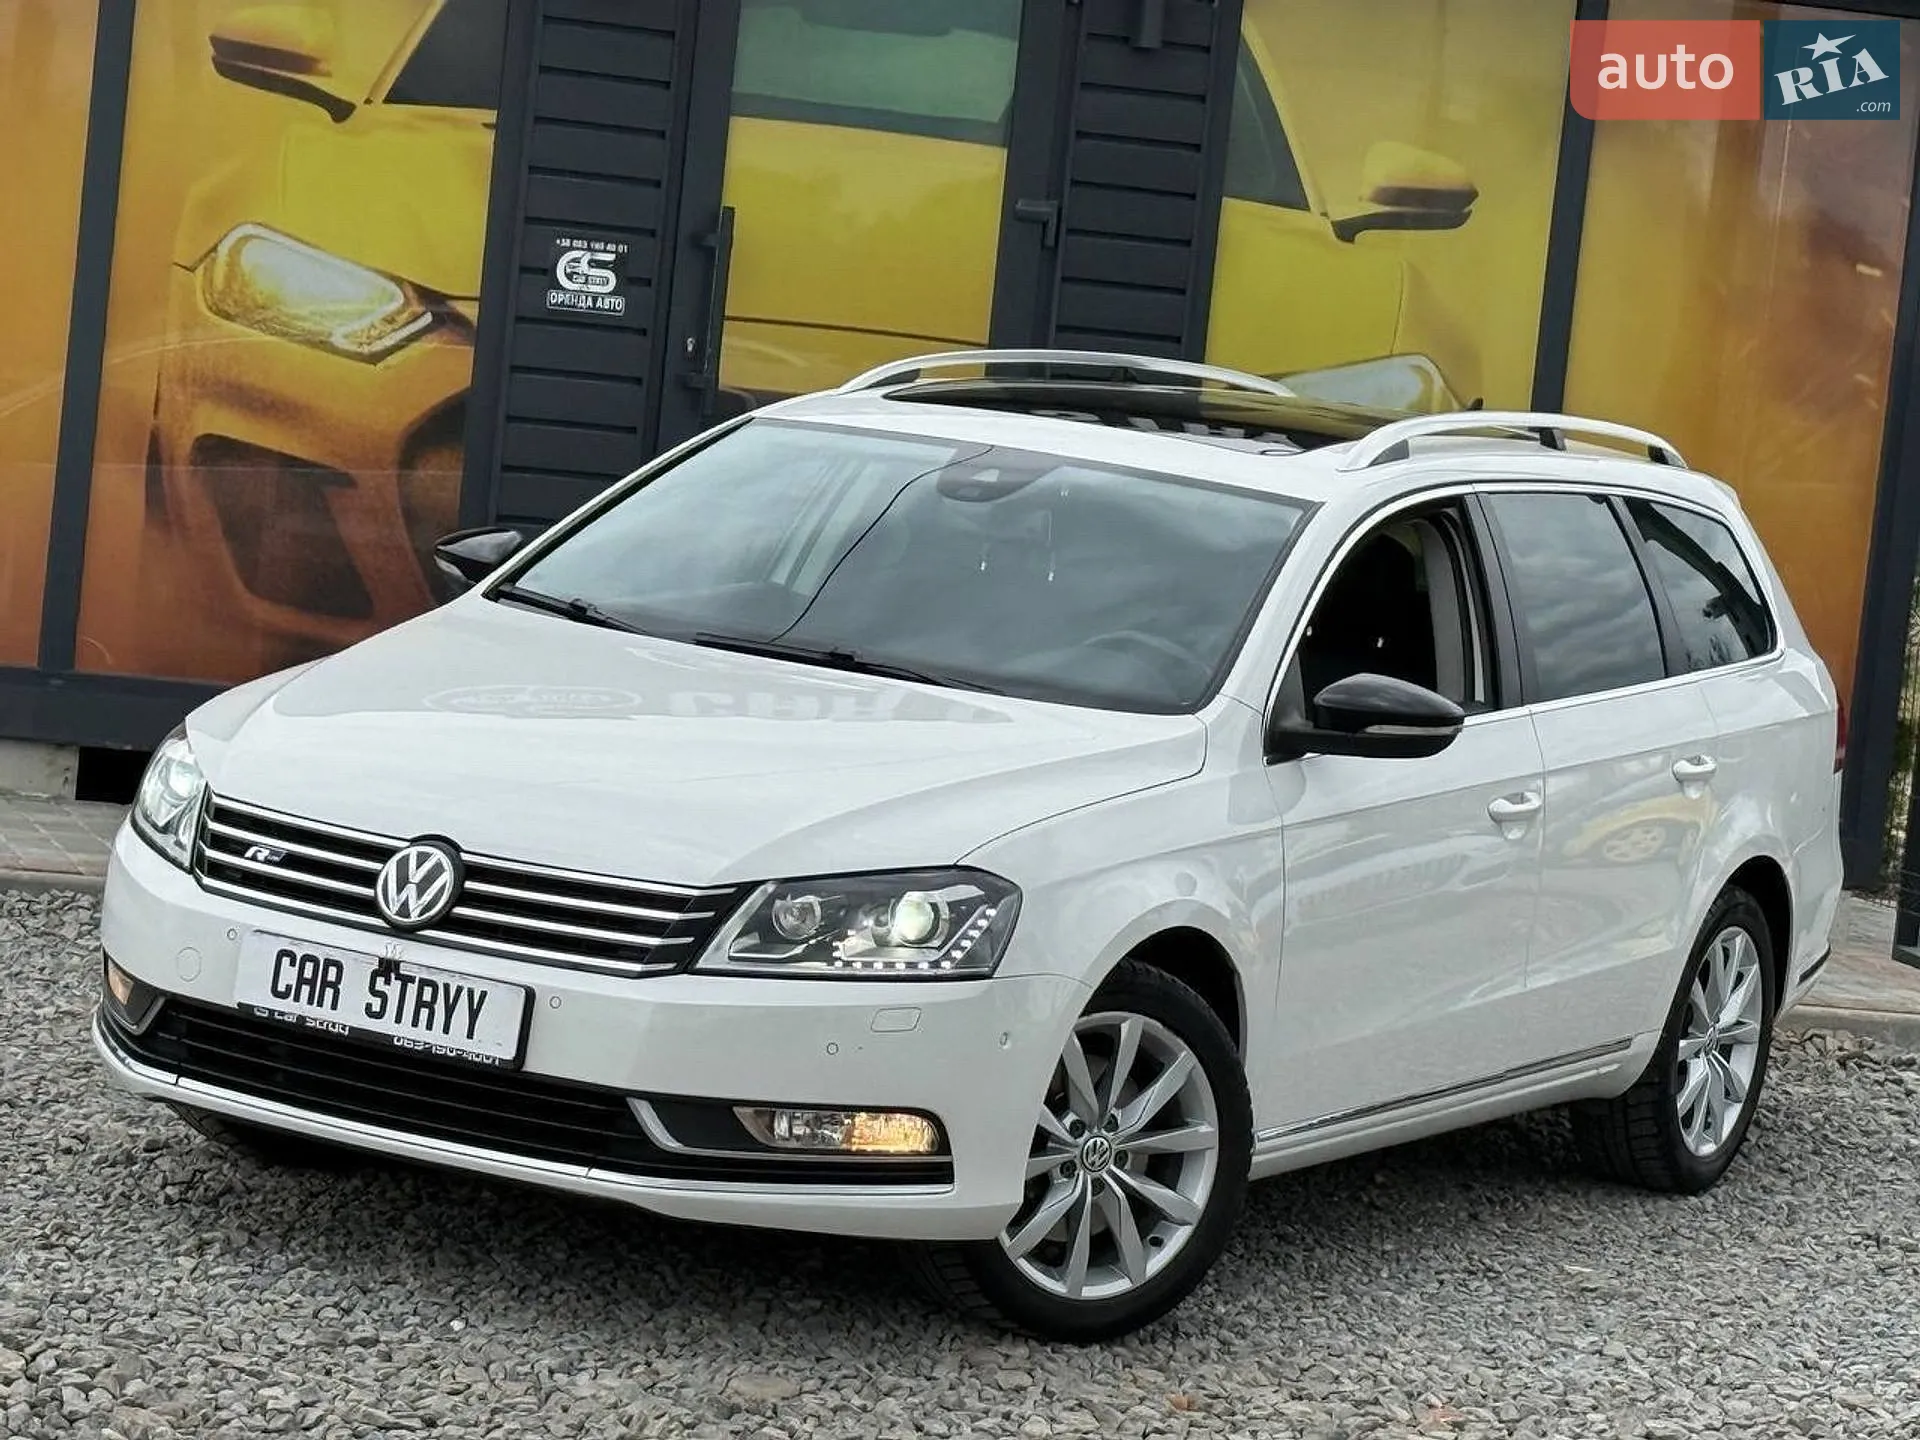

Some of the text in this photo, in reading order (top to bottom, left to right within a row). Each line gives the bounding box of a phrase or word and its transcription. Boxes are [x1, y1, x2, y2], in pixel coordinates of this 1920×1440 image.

[595, 296, 622, 311] АВТО
[270, 949, 488, 1040] CAR STRYY
